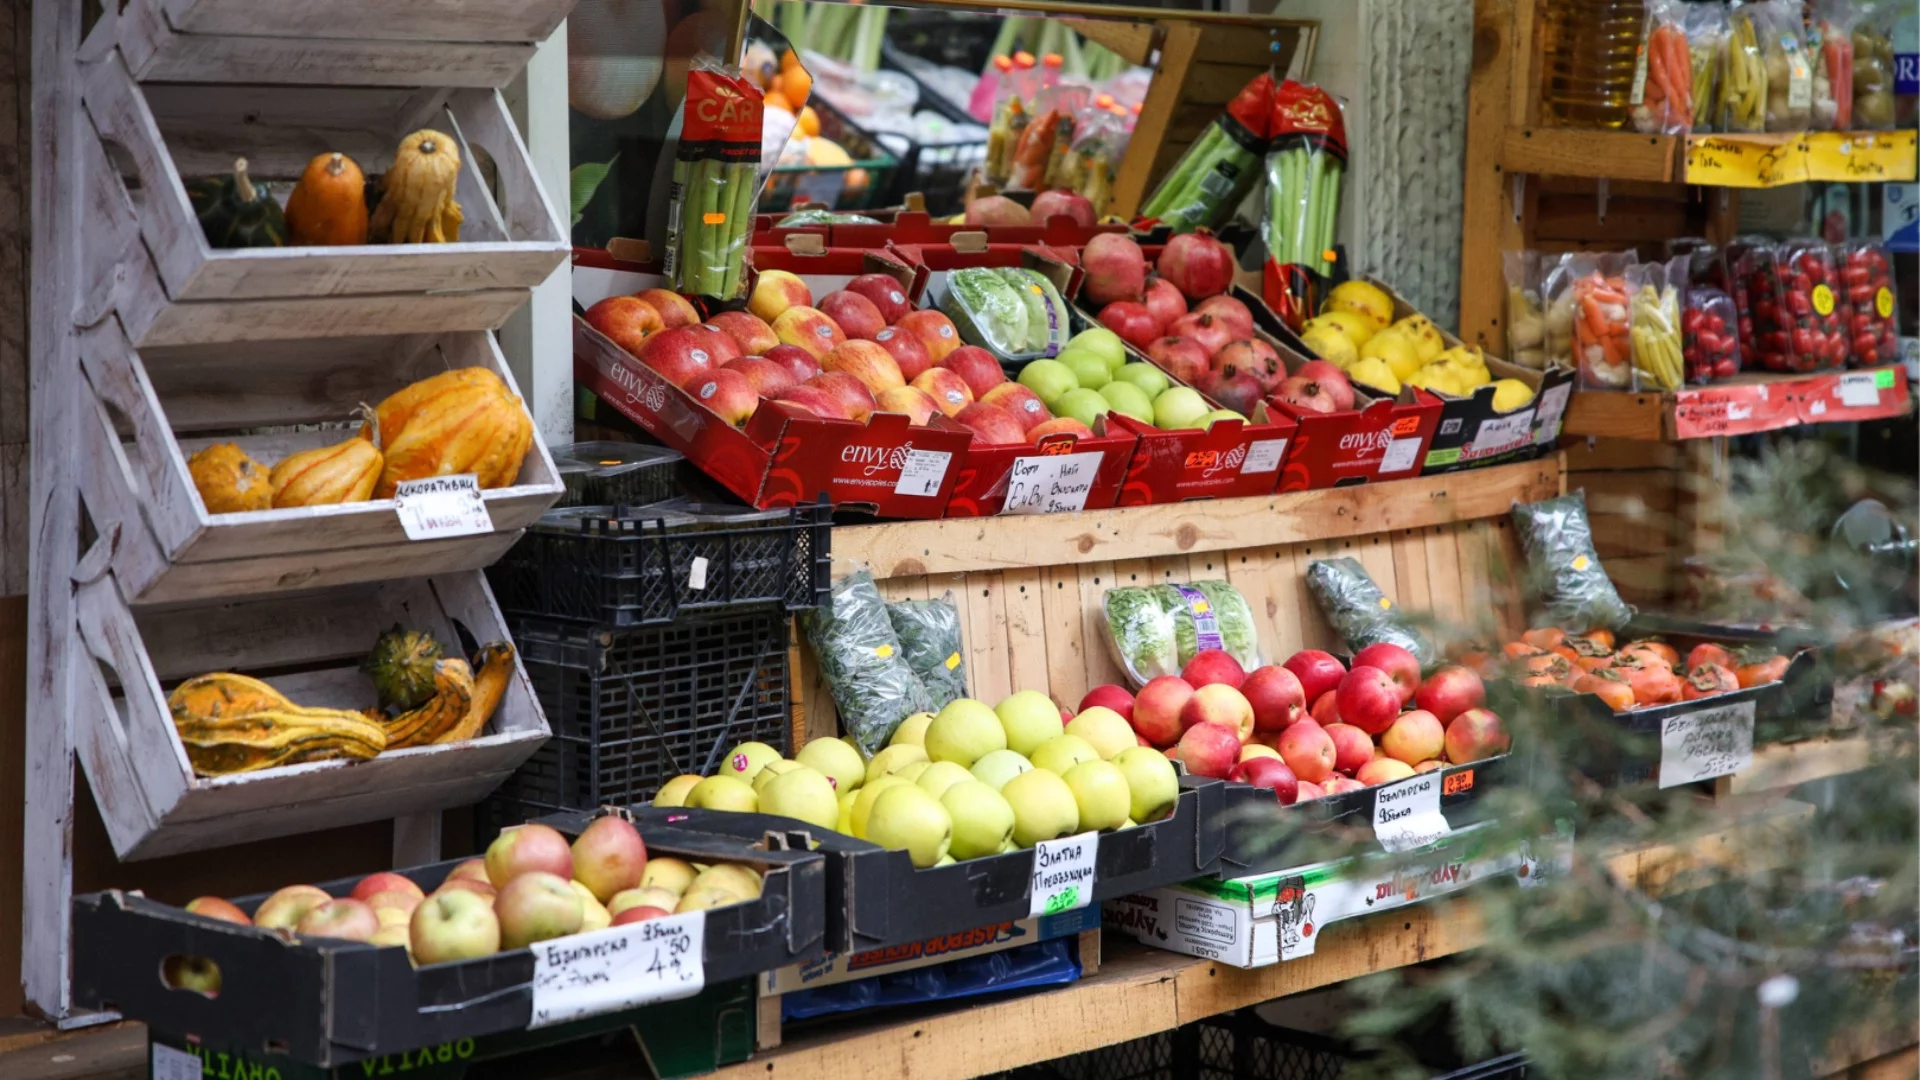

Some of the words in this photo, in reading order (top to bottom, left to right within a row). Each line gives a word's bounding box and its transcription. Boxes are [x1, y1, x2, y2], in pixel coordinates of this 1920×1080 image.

[697, 98, 760, 122] CAR
[611, 362, 647, 404] envy
[1340, 431, 1379, 458] envy
[841, 444, 892, 476] envy
[1196, 946, 1219, 958] CLASS
